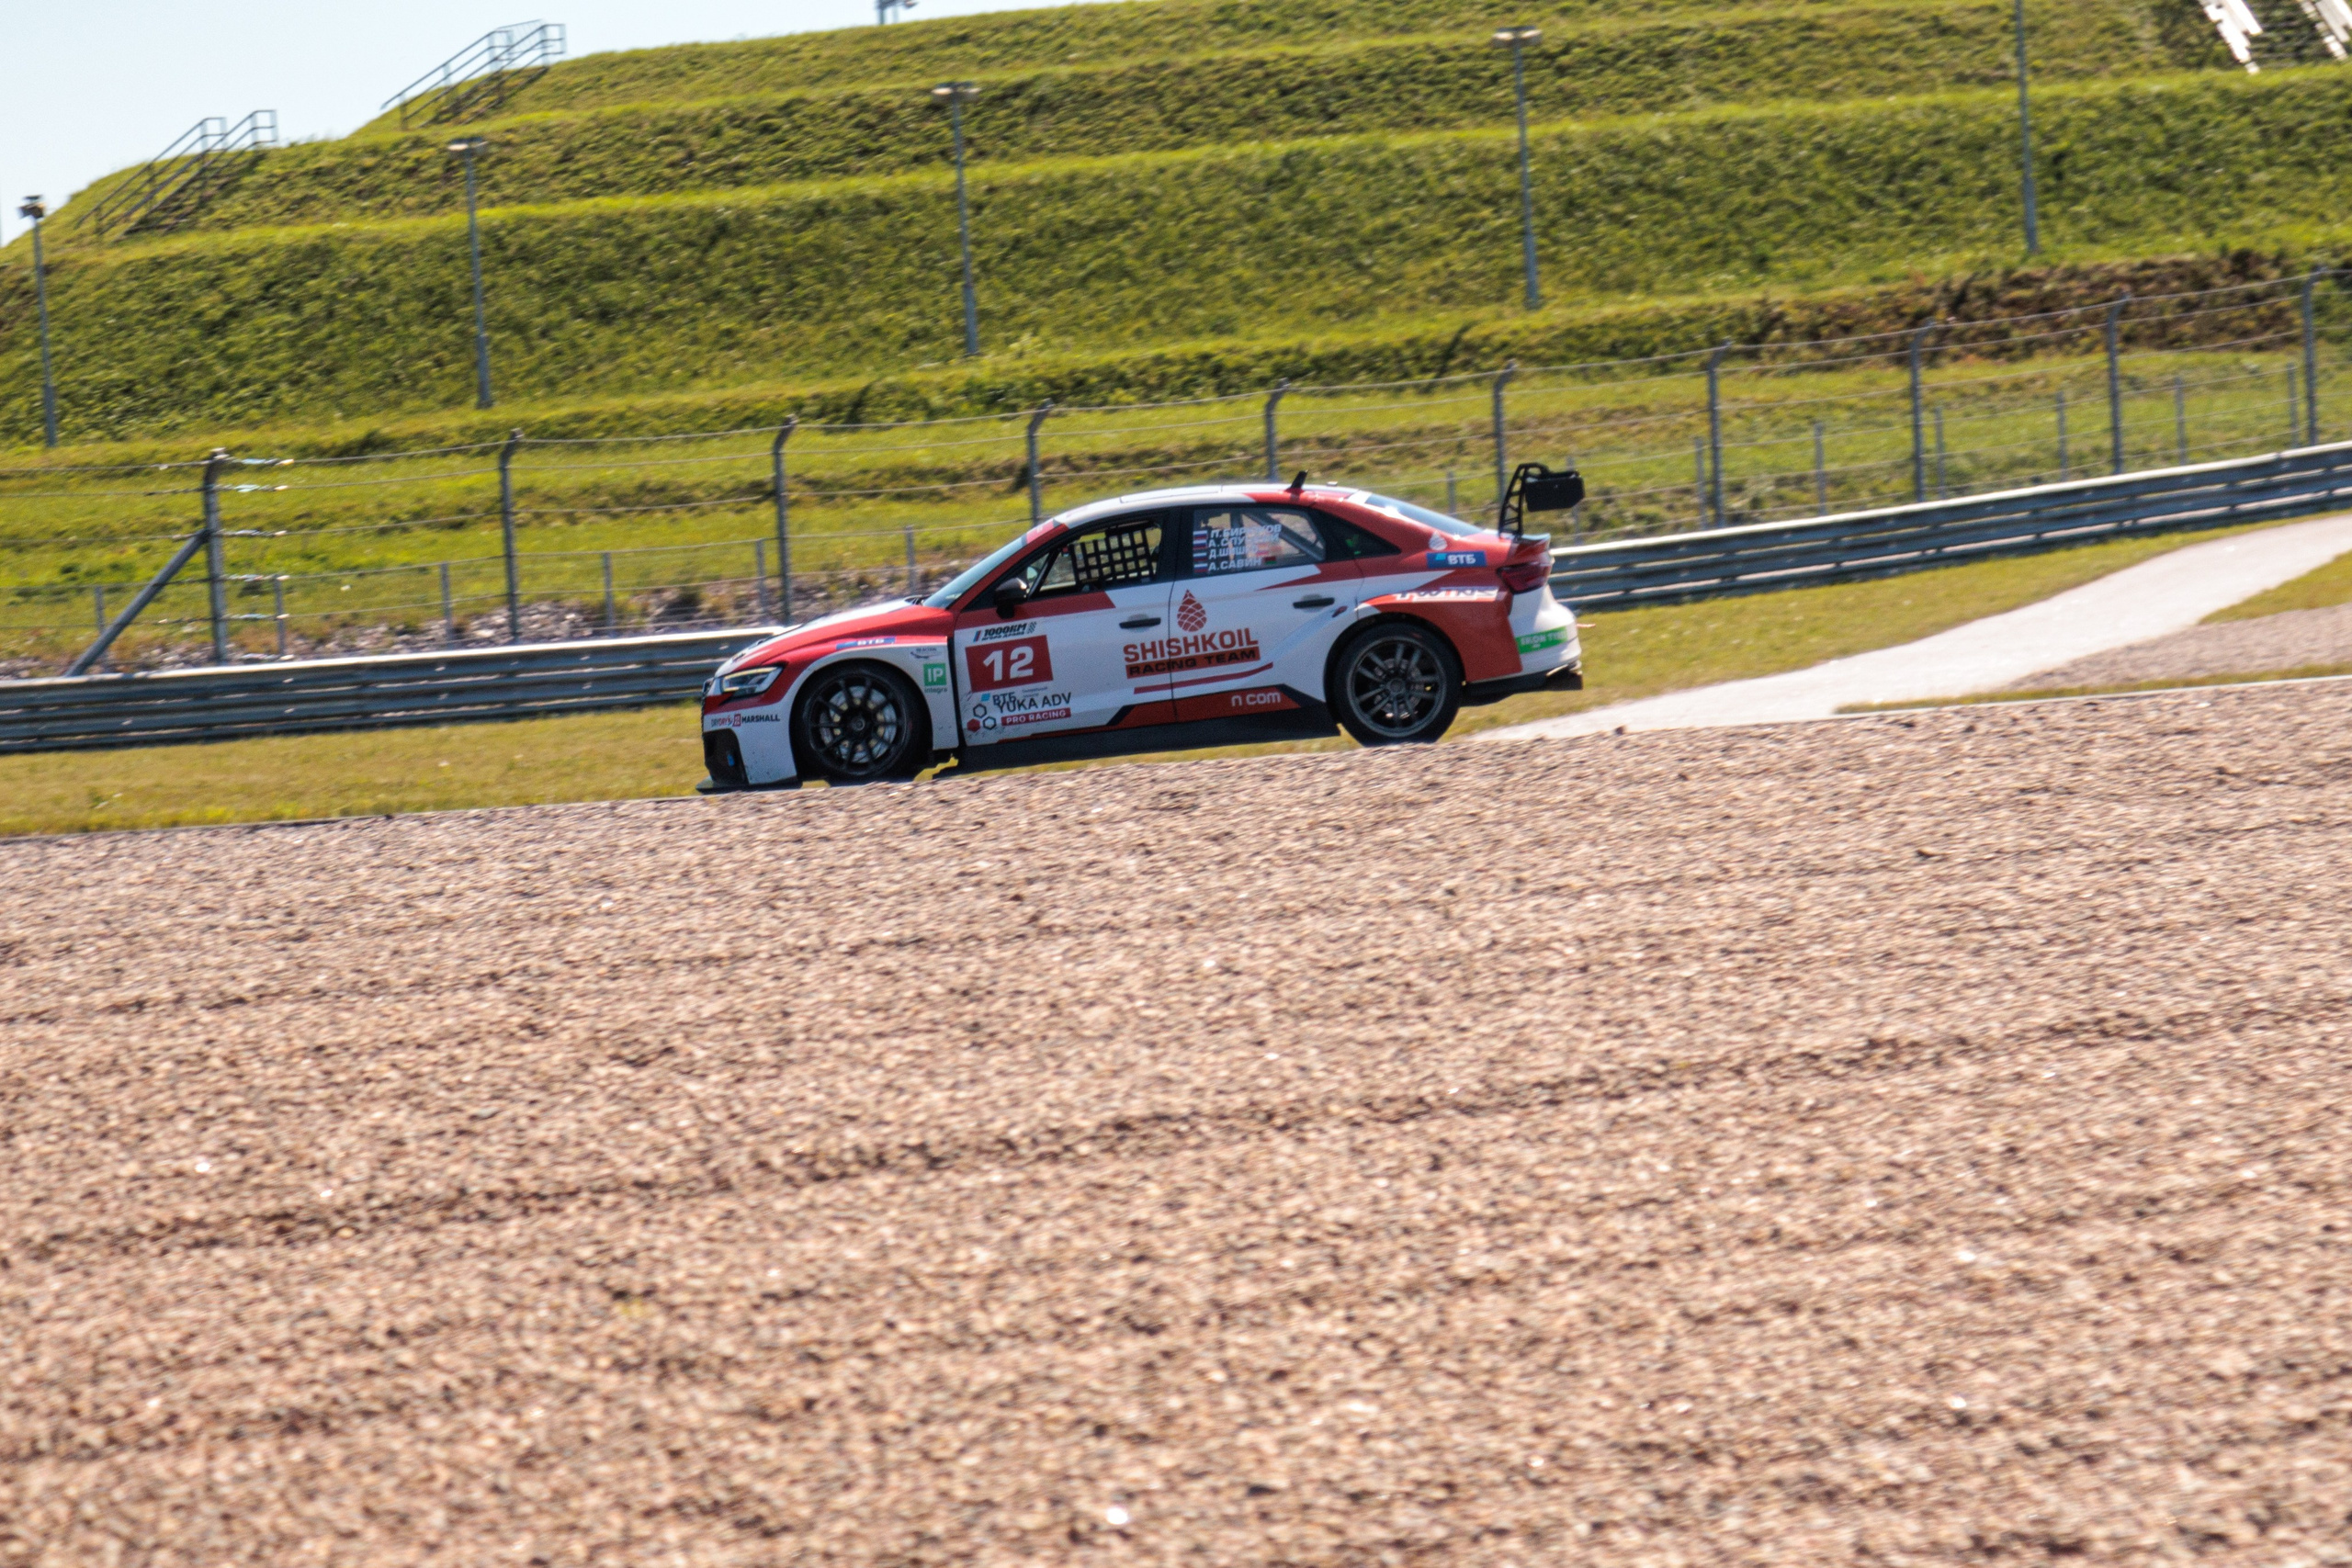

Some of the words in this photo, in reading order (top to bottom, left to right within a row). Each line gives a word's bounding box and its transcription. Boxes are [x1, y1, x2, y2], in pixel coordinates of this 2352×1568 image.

[1208, 557, 1262, 571] А.САВИН
[1447, 553, 1476, 565] ВТБ
[1123, 627, 1259, 663] SHISHKOIL
[982, 646, 1035, 682] 12
[1129, 659, 1198, 676] RACING
[1204, 649, 1256, 664] TEAM
[927, 667, 944, 682] IP
[997, 697, 1039, 714] YUKA
[1041, 692, 1071, 708] ADV
[741, 714, 781, 723] MARSHALL
[1006, 716, 1026, 725] PRO
[1029, 709, 1067, 722] RACING
